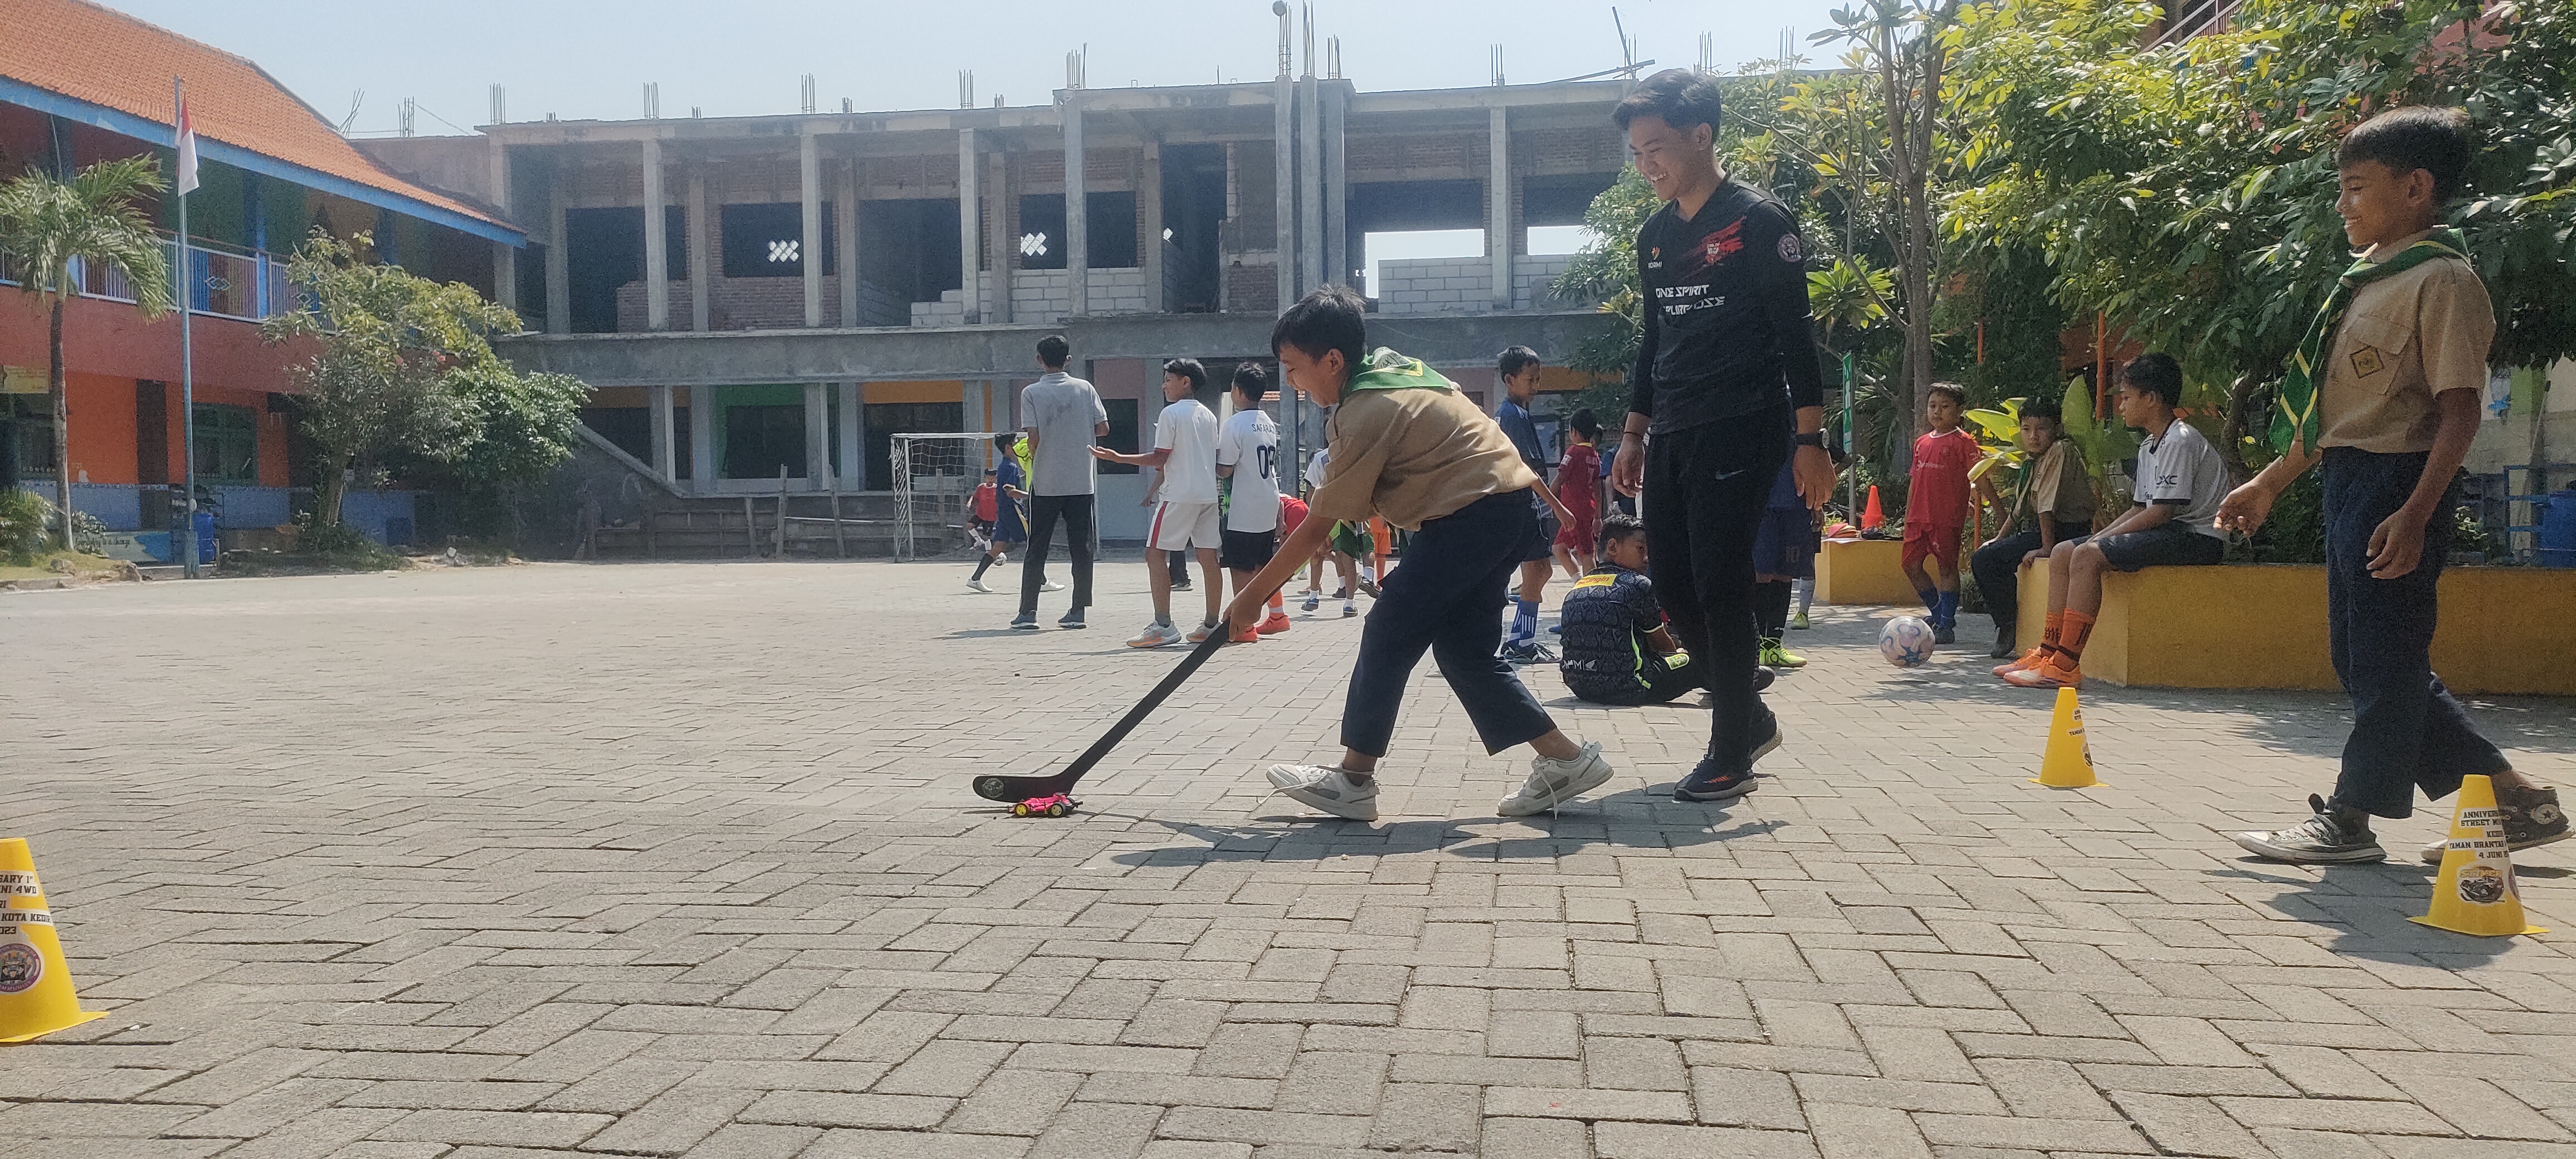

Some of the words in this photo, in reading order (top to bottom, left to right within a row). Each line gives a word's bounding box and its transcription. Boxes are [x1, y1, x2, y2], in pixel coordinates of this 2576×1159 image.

[1655, 286, 1674, 298] ONE
[1675, 284, 1710, 297] SPIRIT
[1, 913, 27, 922] KOTA
